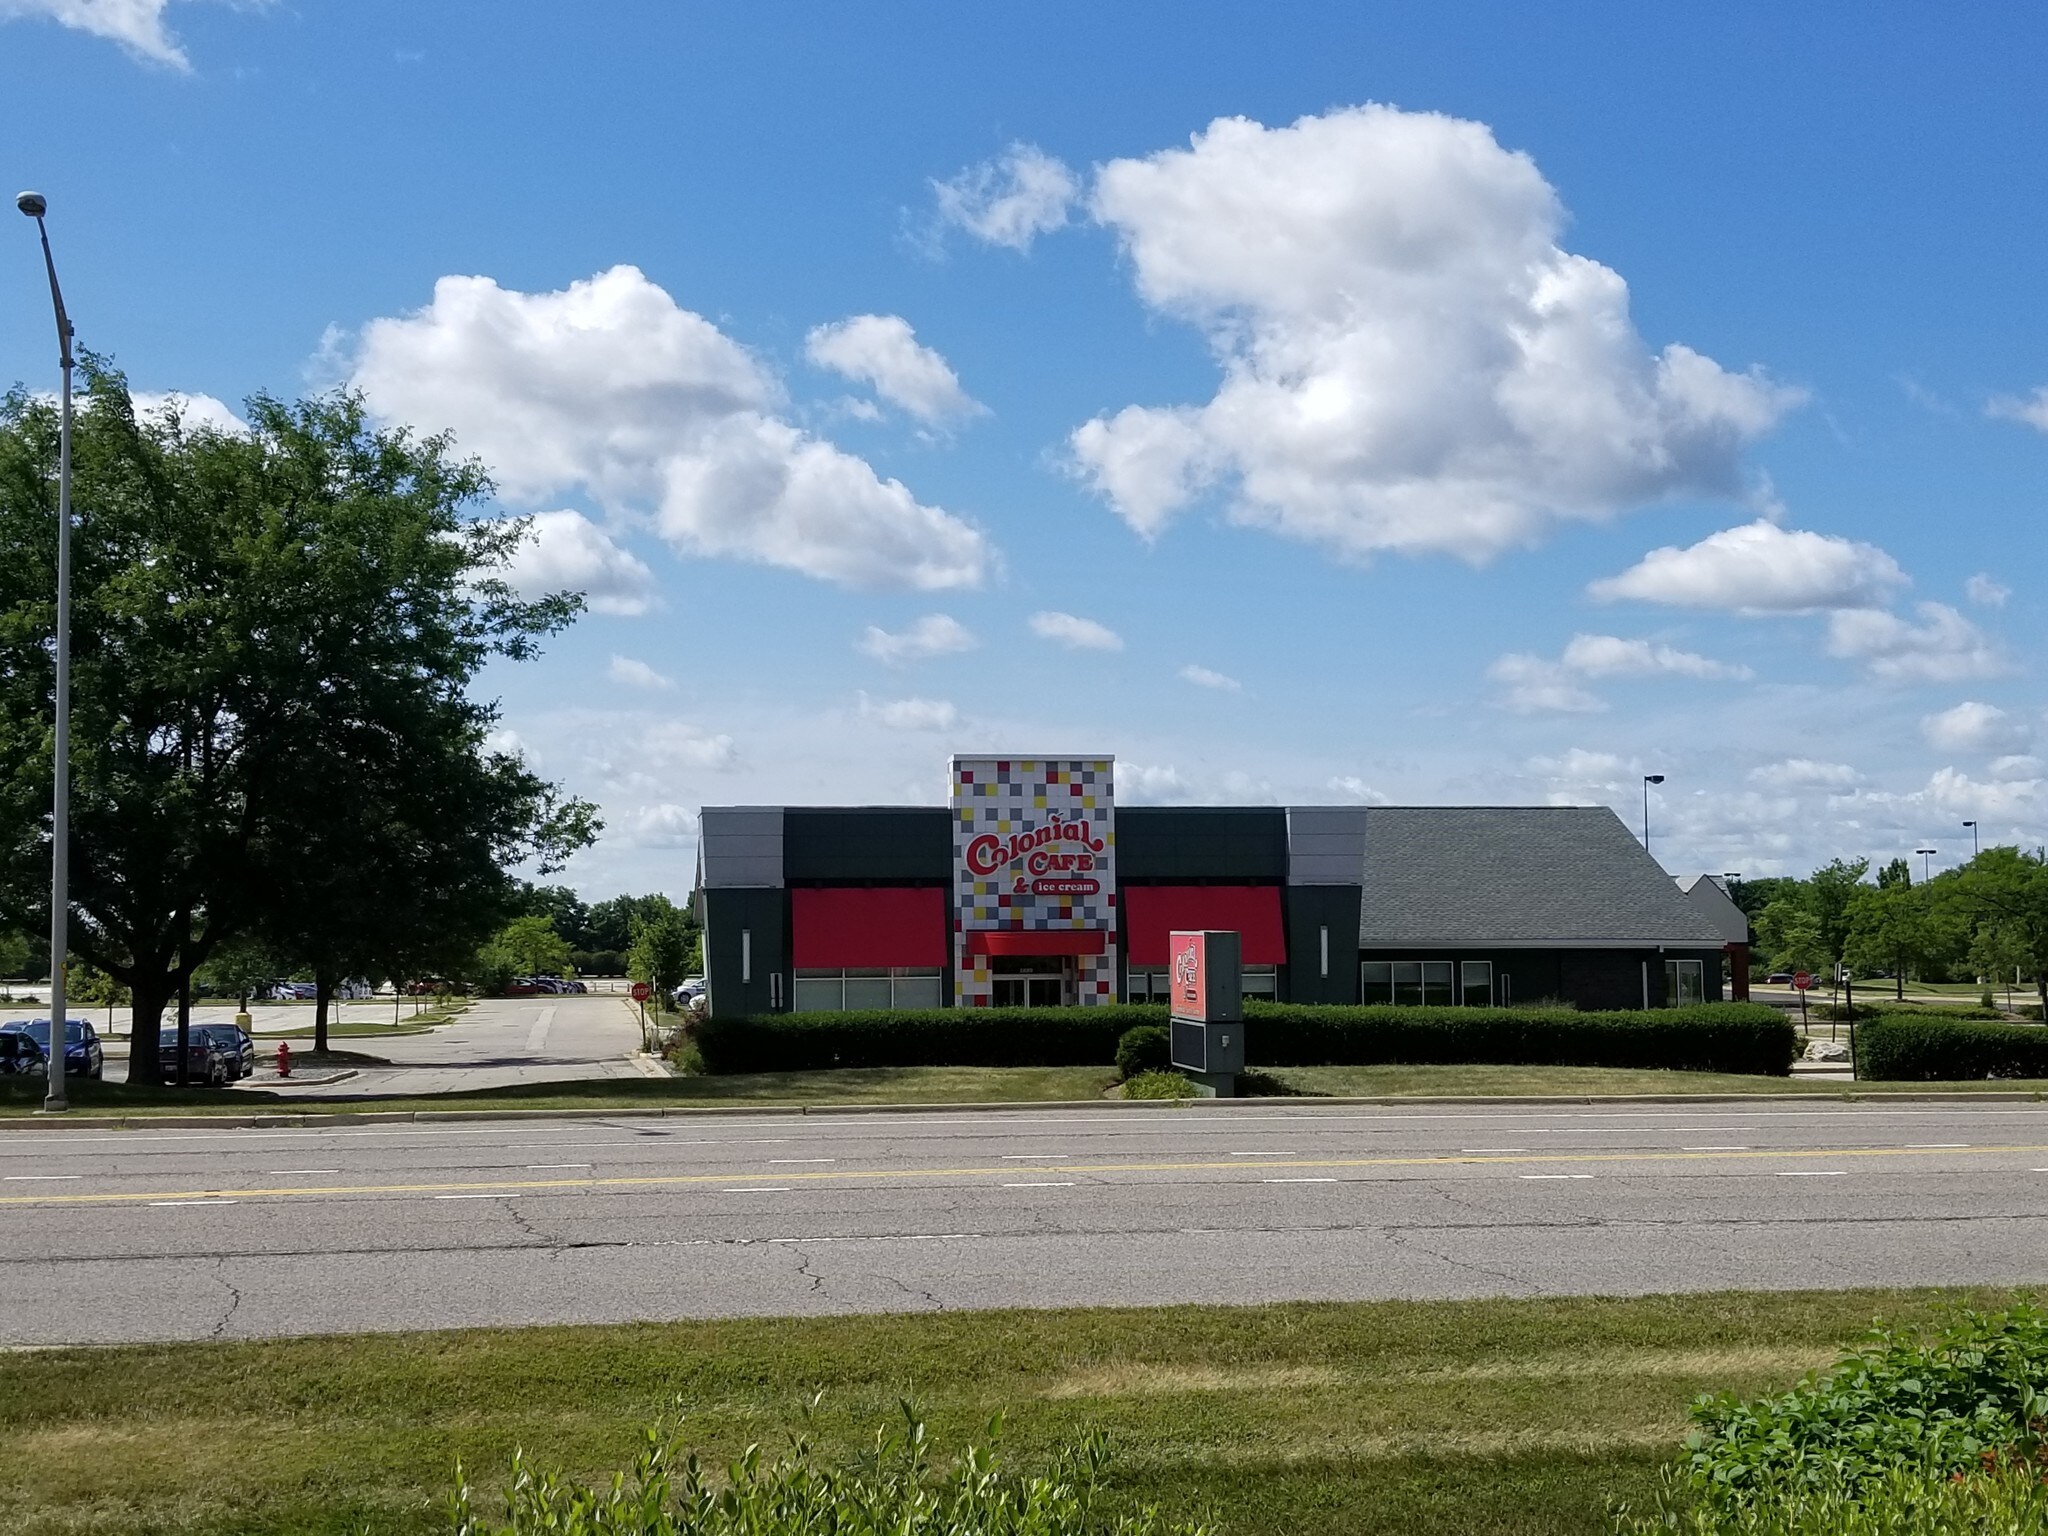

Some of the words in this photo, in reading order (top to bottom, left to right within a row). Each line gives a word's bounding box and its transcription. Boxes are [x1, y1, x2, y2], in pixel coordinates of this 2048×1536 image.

[966, 814, 1104, 876] Colonial
[1028, 851, 1094, 876] CAFE
[1013, 877, 1029, 893] &
[1038, 882, 1055, 891] ice
[1794, 977, 1810, 985] STOP
[633, 988, 649, 996] STOP
